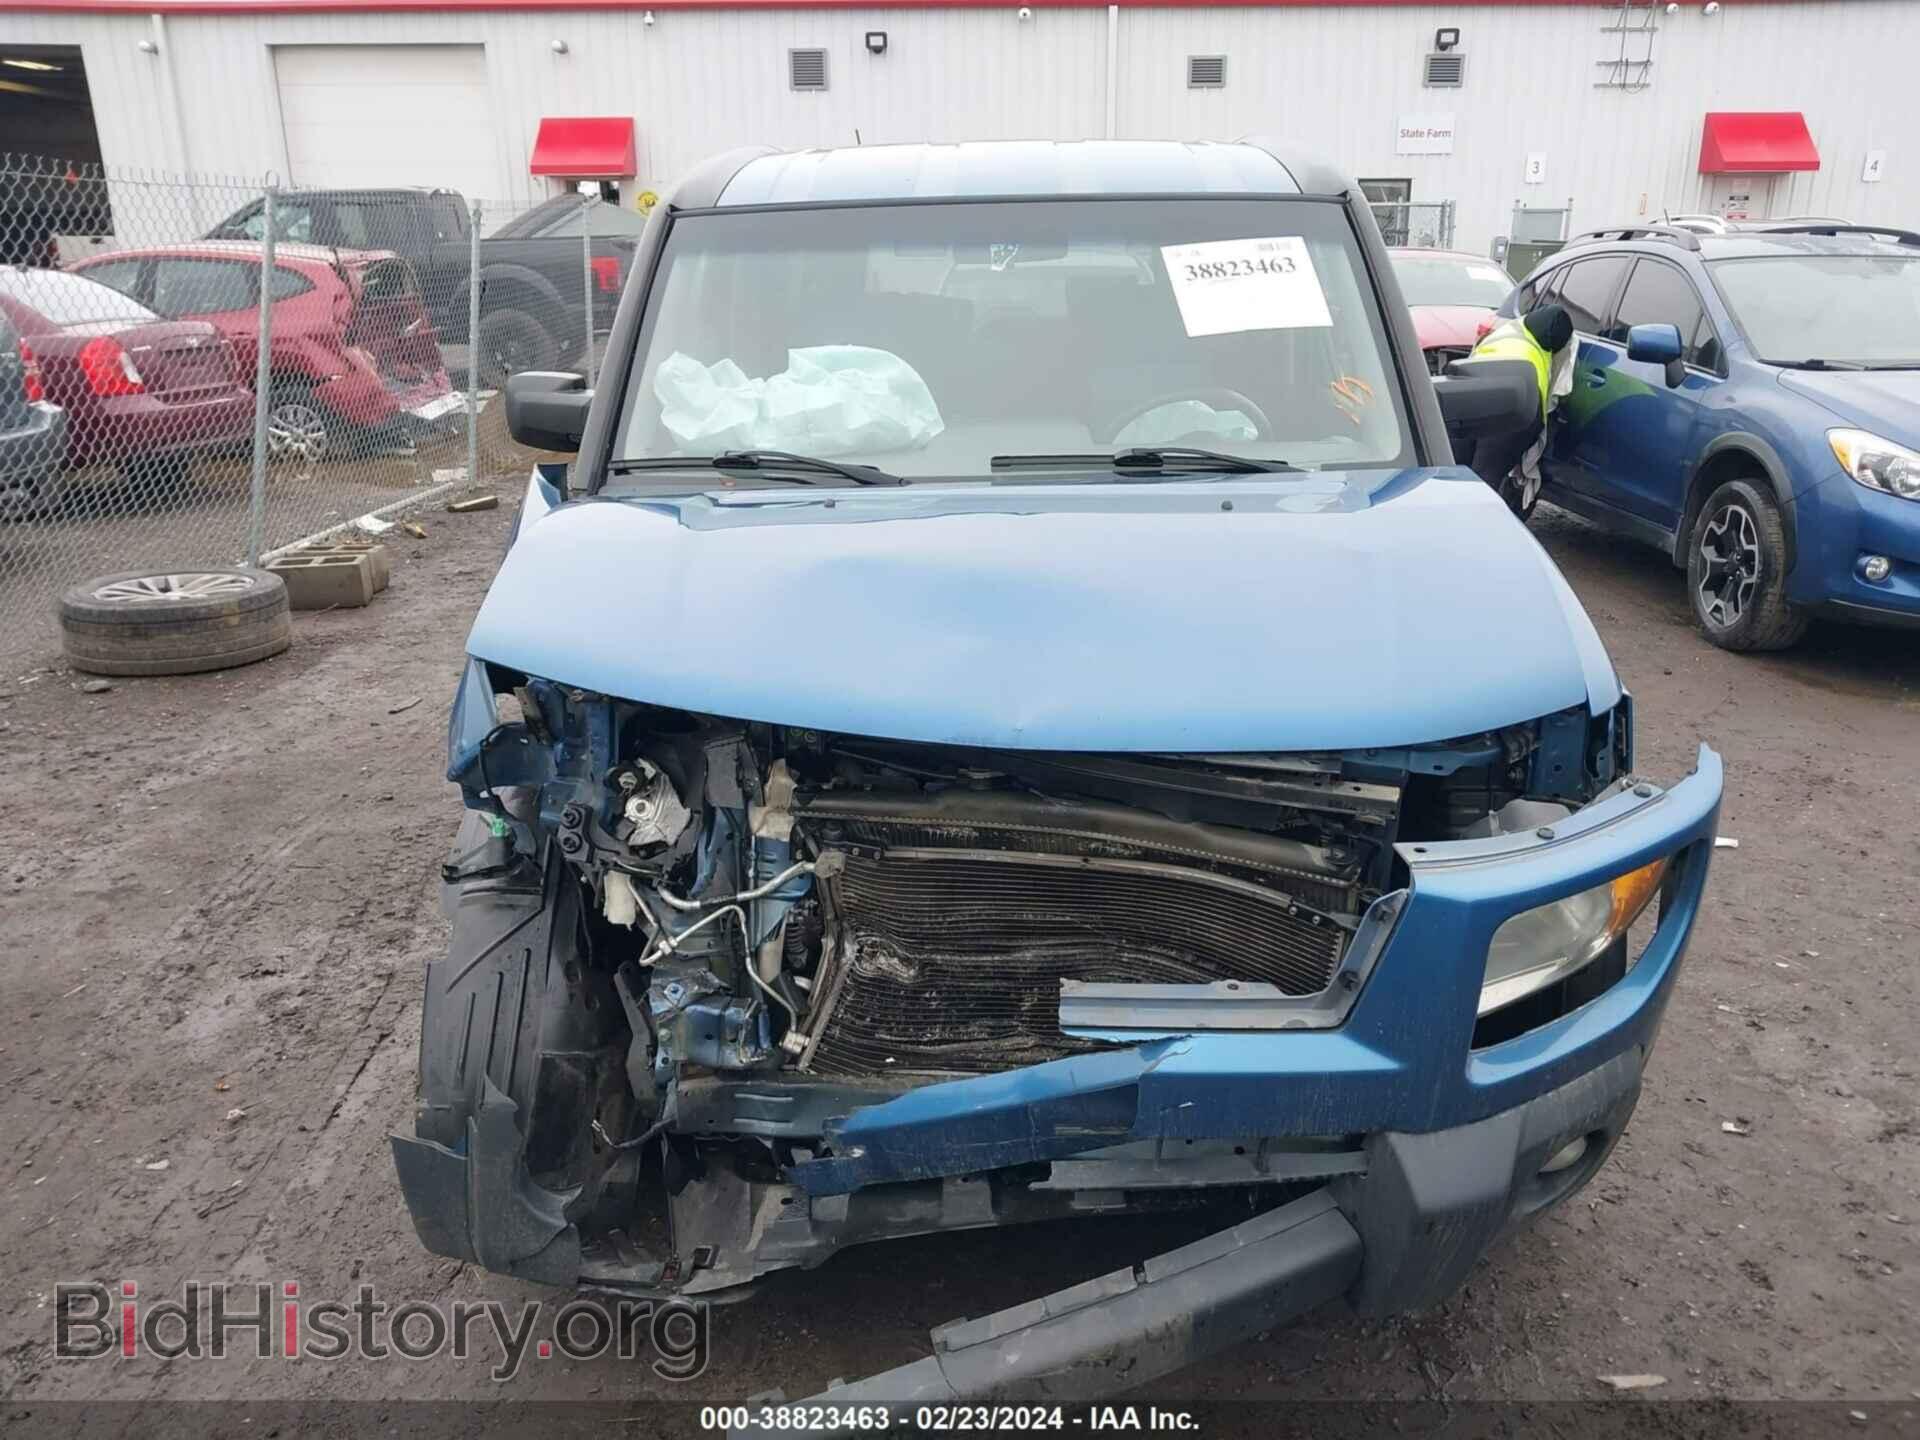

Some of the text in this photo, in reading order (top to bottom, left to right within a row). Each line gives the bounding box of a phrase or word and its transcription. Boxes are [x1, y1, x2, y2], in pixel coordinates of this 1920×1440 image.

[1400, 128, 1452, 138] State Farm
[1531, 160, 1540, 174] 3
[1870, 160, 1879, 173] 4
[1184, 256, 1297, 281] 38823463
